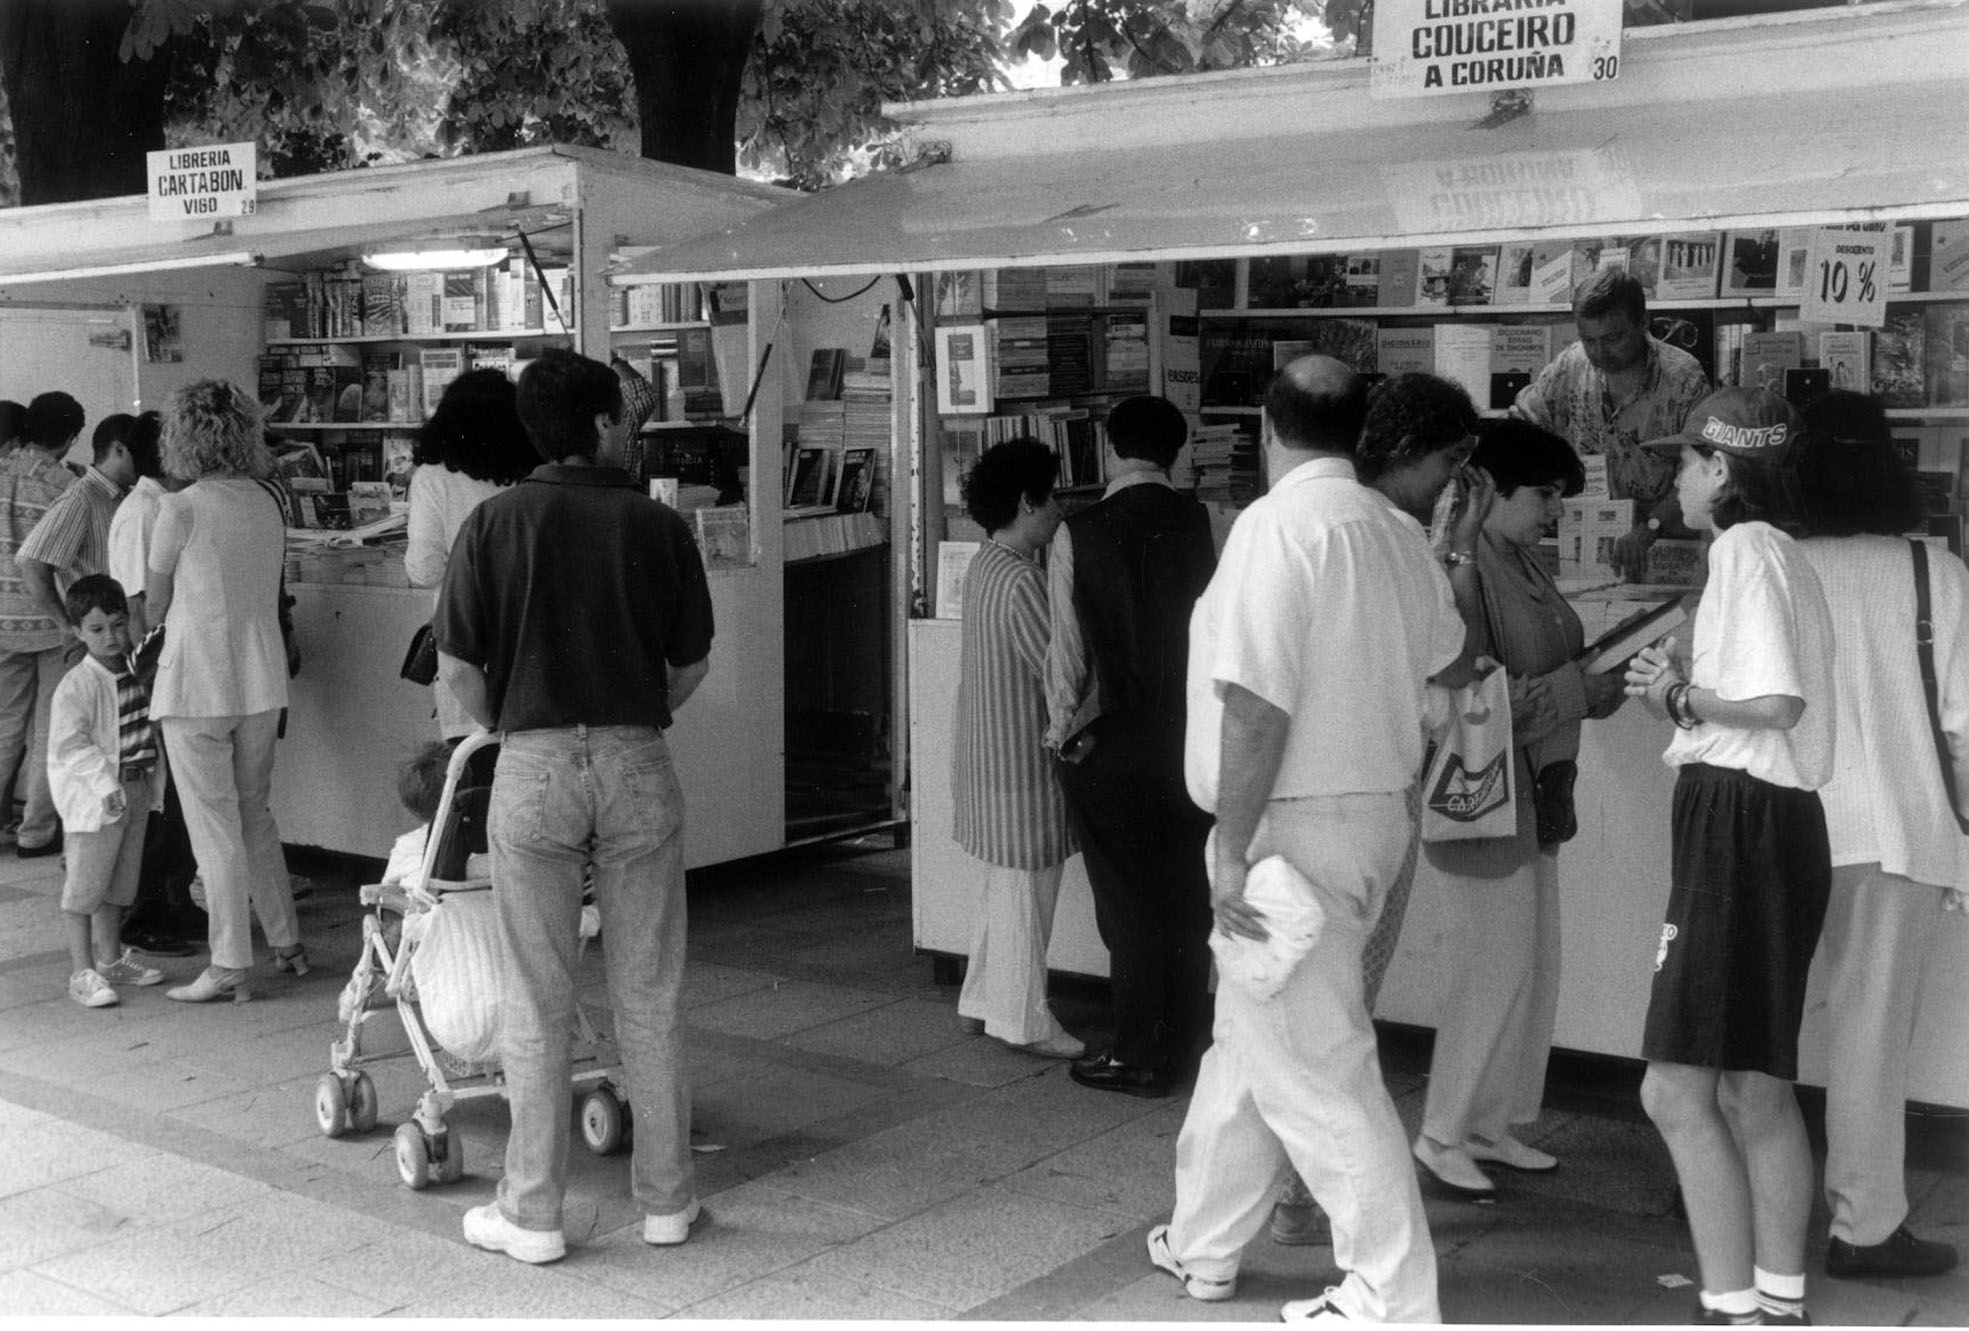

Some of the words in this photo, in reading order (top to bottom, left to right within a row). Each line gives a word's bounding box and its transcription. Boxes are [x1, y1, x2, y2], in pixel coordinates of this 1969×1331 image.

[1412, 12, 1576, 60] COUCEIRO
[1423, 65, 1444, 88] A
[1451, 51, 1565, 87] CORUÑA
[1593, 55, 1618, 81] 30
[169, 150, 231, 170] LIBRERIA
[183, 197, 218, 215] VIGO
[1820, 258, 1848, 303] 10
[1858, 260, 1876, 303] %
[1702, 415, 1788, 448] GIANTS
